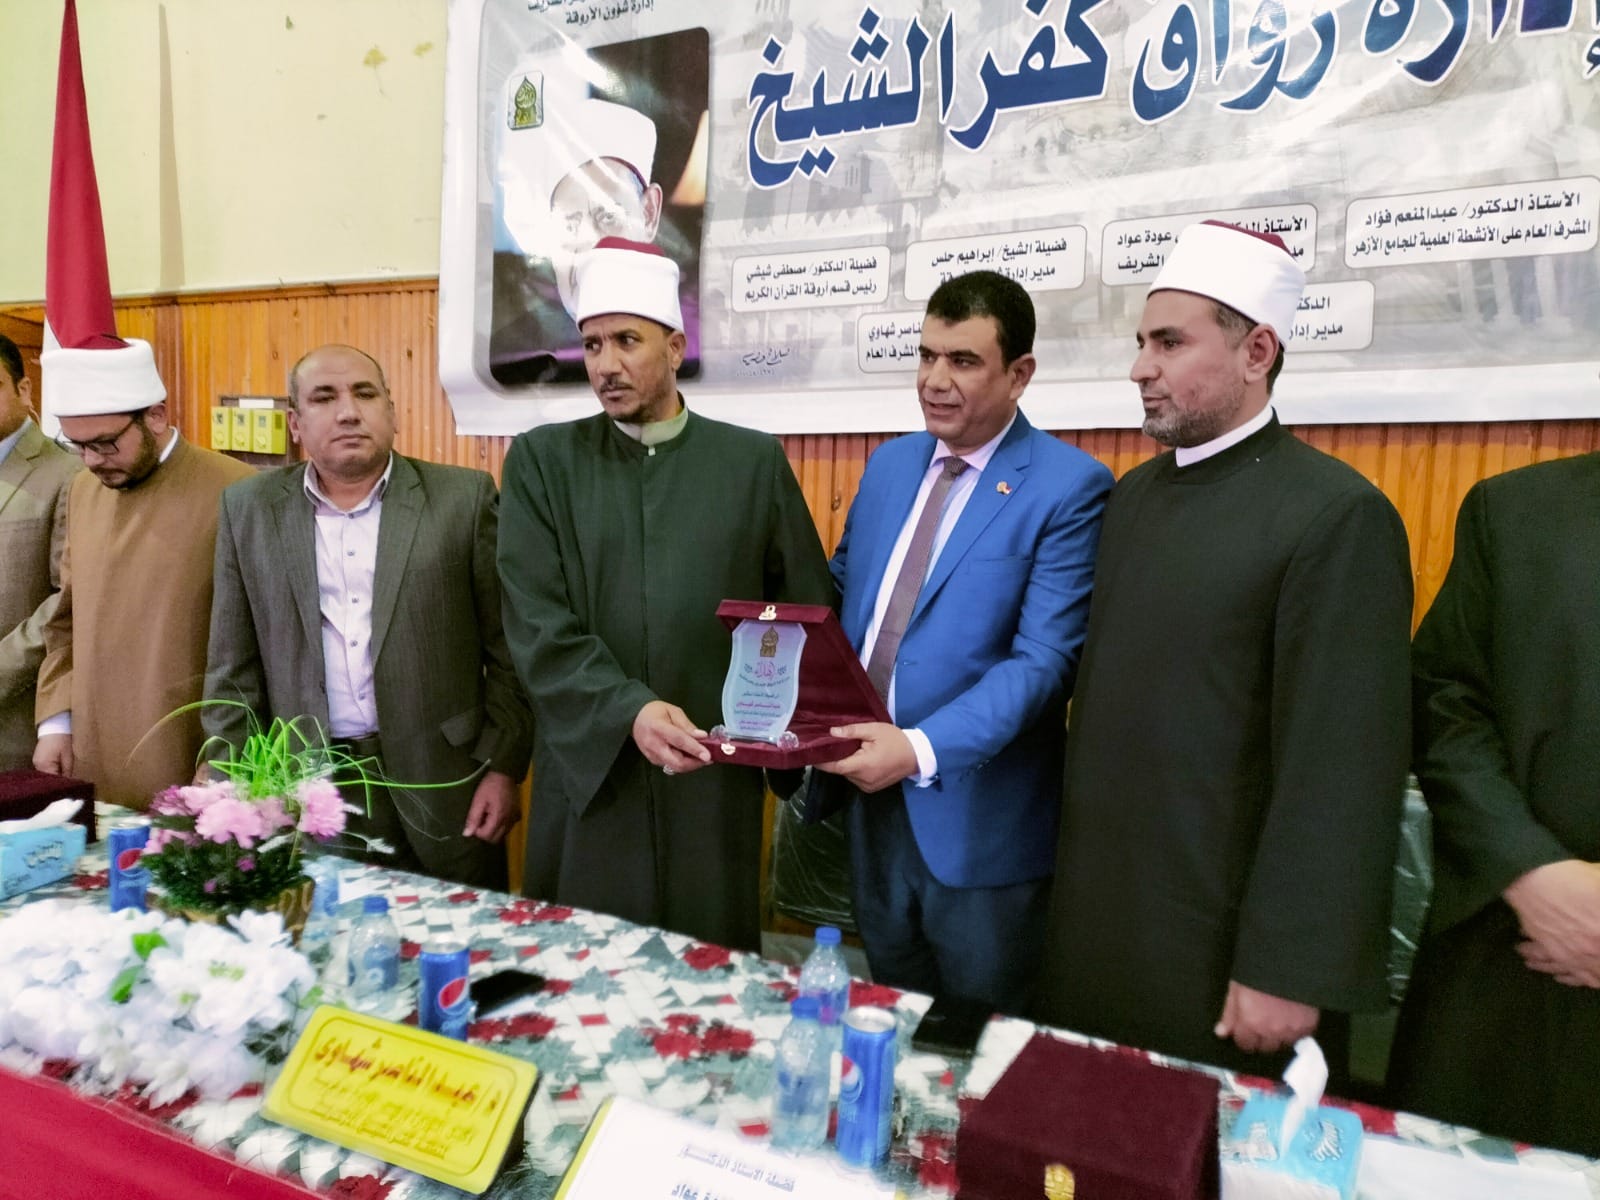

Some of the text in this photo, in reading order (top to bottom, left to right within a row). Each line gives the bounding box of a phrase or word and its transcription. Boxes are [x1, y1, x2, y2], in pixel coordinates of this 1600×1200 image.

[948, 0, 1110, 151] كفر
[747, 6, 958, 190] الشيخ
[1527, 191, 1581, 212] الأستاذ
[1365, 208, 1392, 228] فؤاد
[1035, 237, 1067, 257] فضيلة
[1117, 232, 1142, 248] عواد
[1143, 229, 1172, 247] عودة
[1352, 218, 1591, 257] المشرف العام على الأنشطة العلمية للجامع الأزهر
[850, 255, 877, 274] فضيلة
[956, 247, 995, 266] إبراهيم
[1117, 254, 1165, 275] الشريف
[1030, 266, 1056, 282] مدير
[744, 286, 773, 303] الكريم
[830, 280, 851, 296] قسم
[852, 279, 877, 296] رئيس
[1296, 296, 1331, 312] الدكت
[1288, 323, 1344, 341] مدير إدار
[865, 343, 918, 363] المشرف العام
